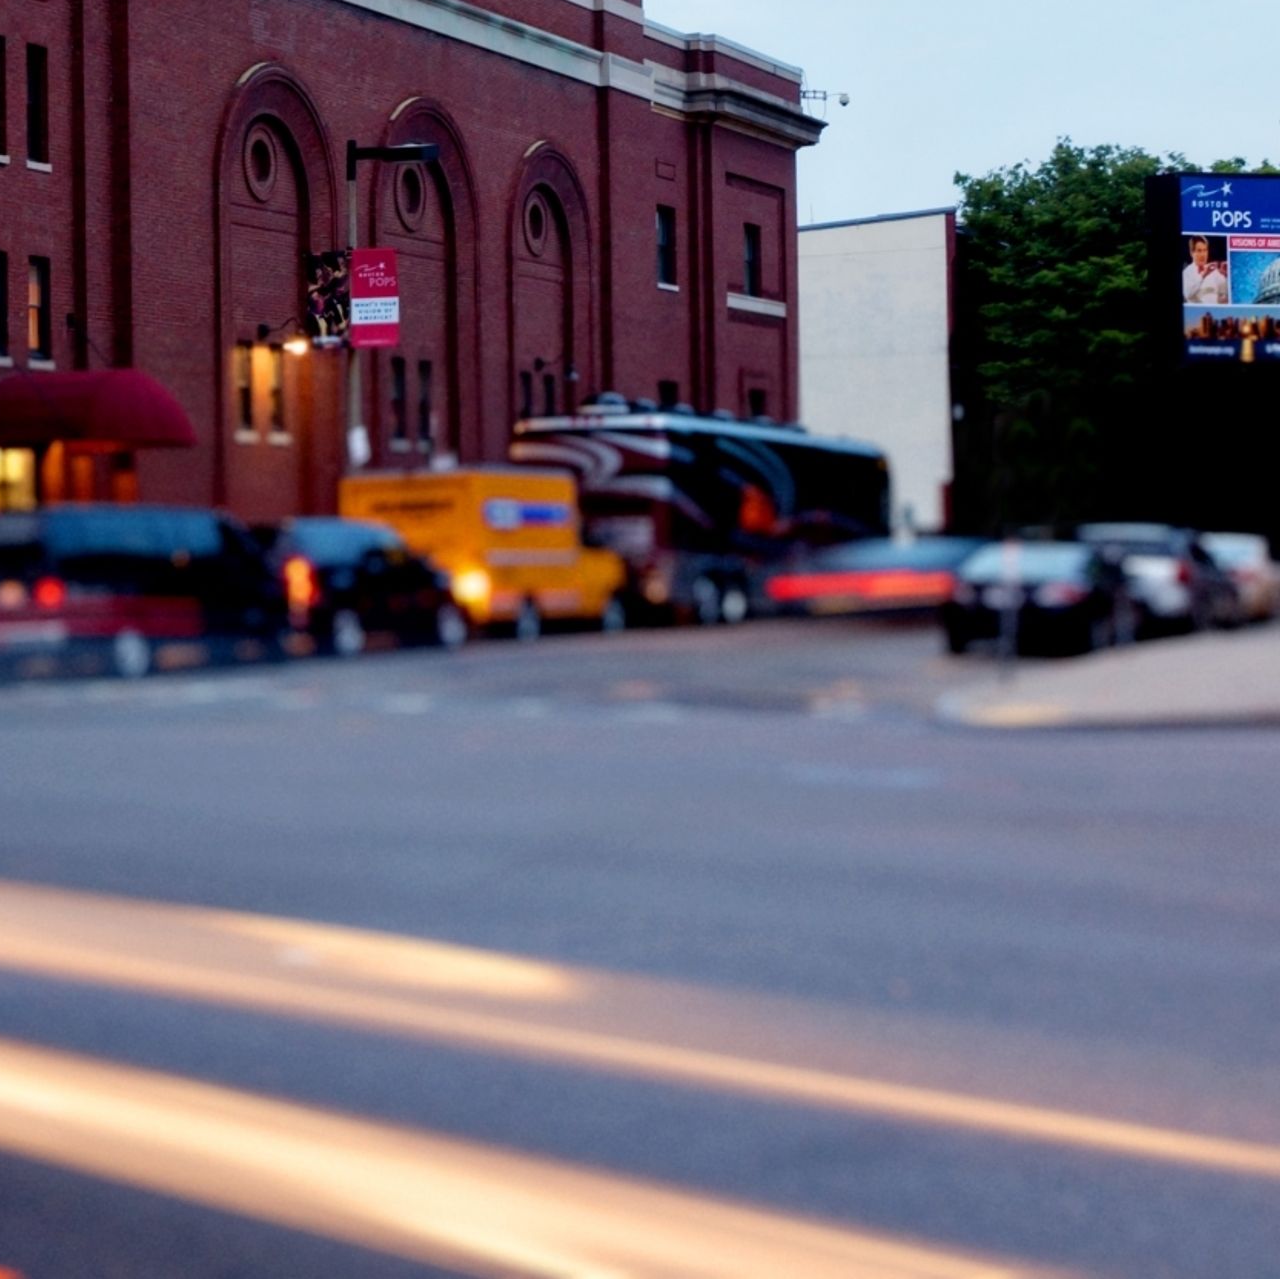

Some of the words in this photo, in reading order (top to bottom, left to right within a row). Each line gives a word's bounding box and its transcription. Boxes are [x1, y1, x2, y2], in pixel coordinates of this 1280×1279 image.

[1191, 200, 1229, 209] BOSTON
[1212, 210, 1253, 228] POPS
[1231, 238, 1257, 247] VISIONS
[369, 277, 397, 288] POPS
